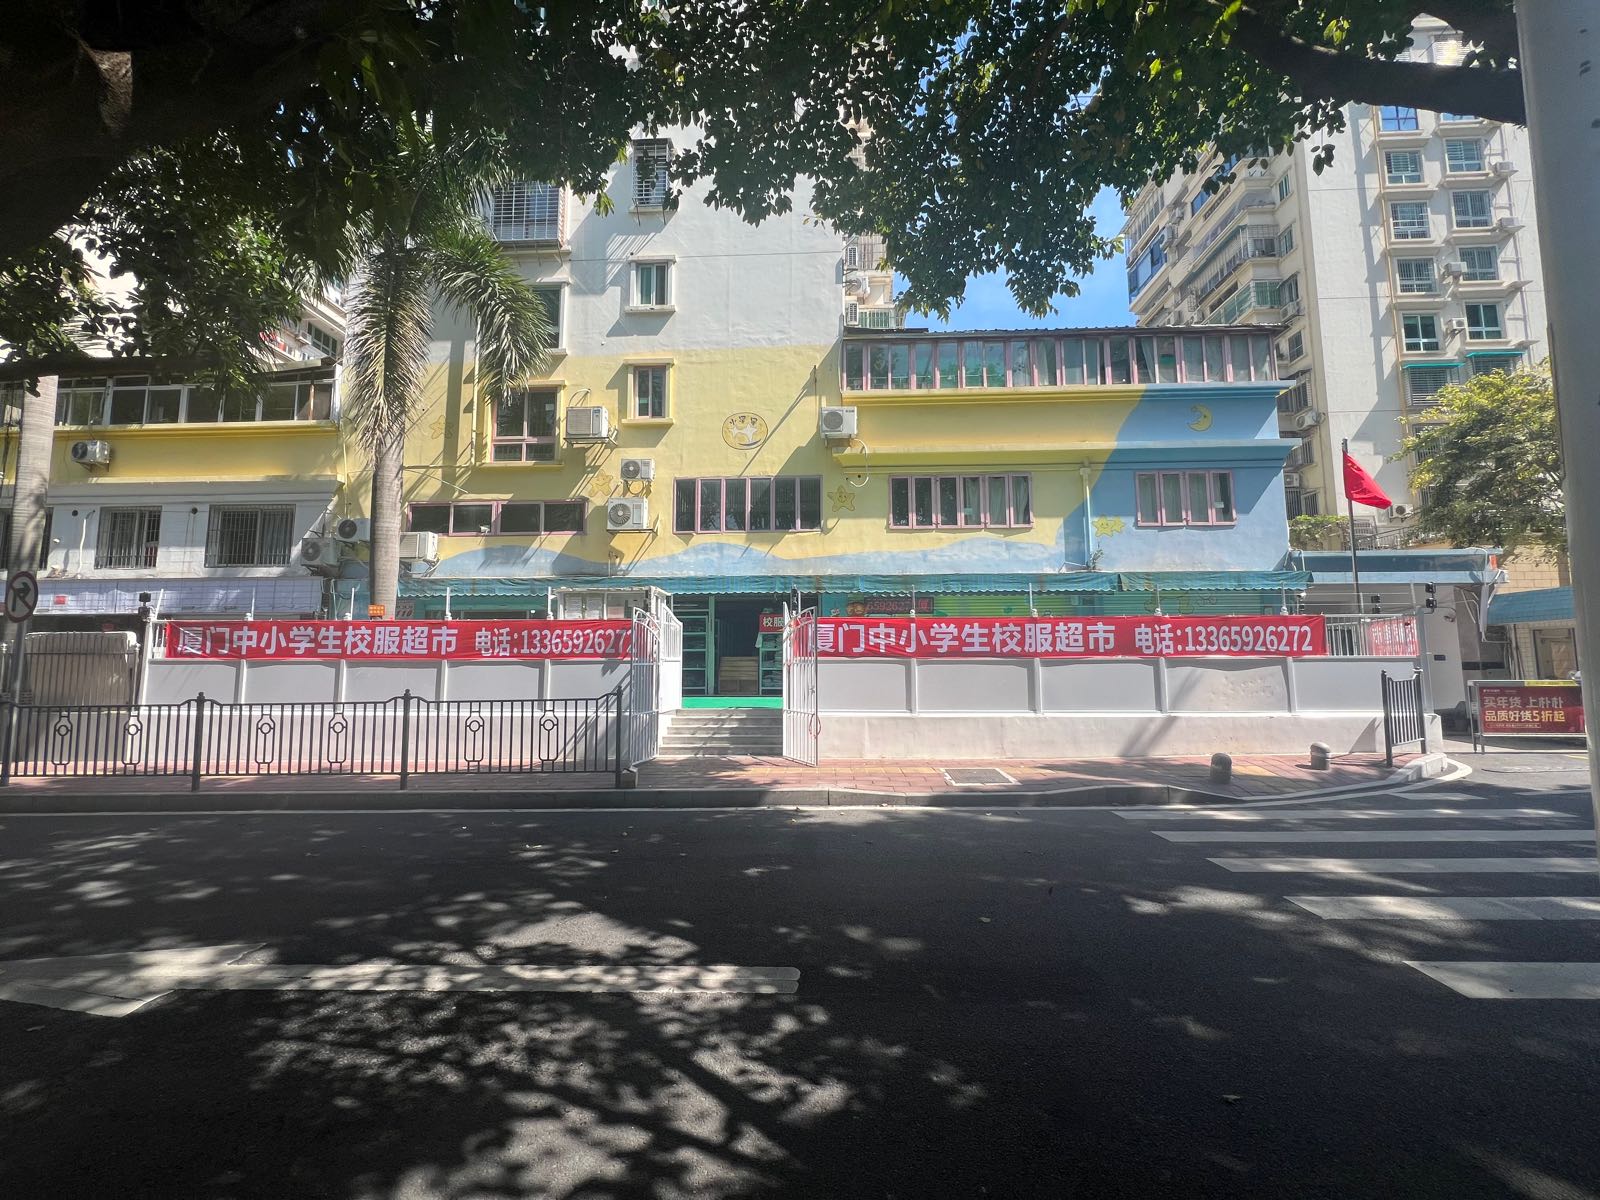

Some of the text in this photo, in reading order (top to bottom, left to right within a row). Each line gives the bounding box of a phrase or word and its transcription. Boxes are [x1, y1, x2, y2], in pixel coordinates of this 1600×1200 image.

[176, 625, 459, 656] 厦门中小学生校服超市
[807, 622, 1116, 653] 厦门中小学生校服超市
[1485, 710, 1566, 722] 品质好货5折起
